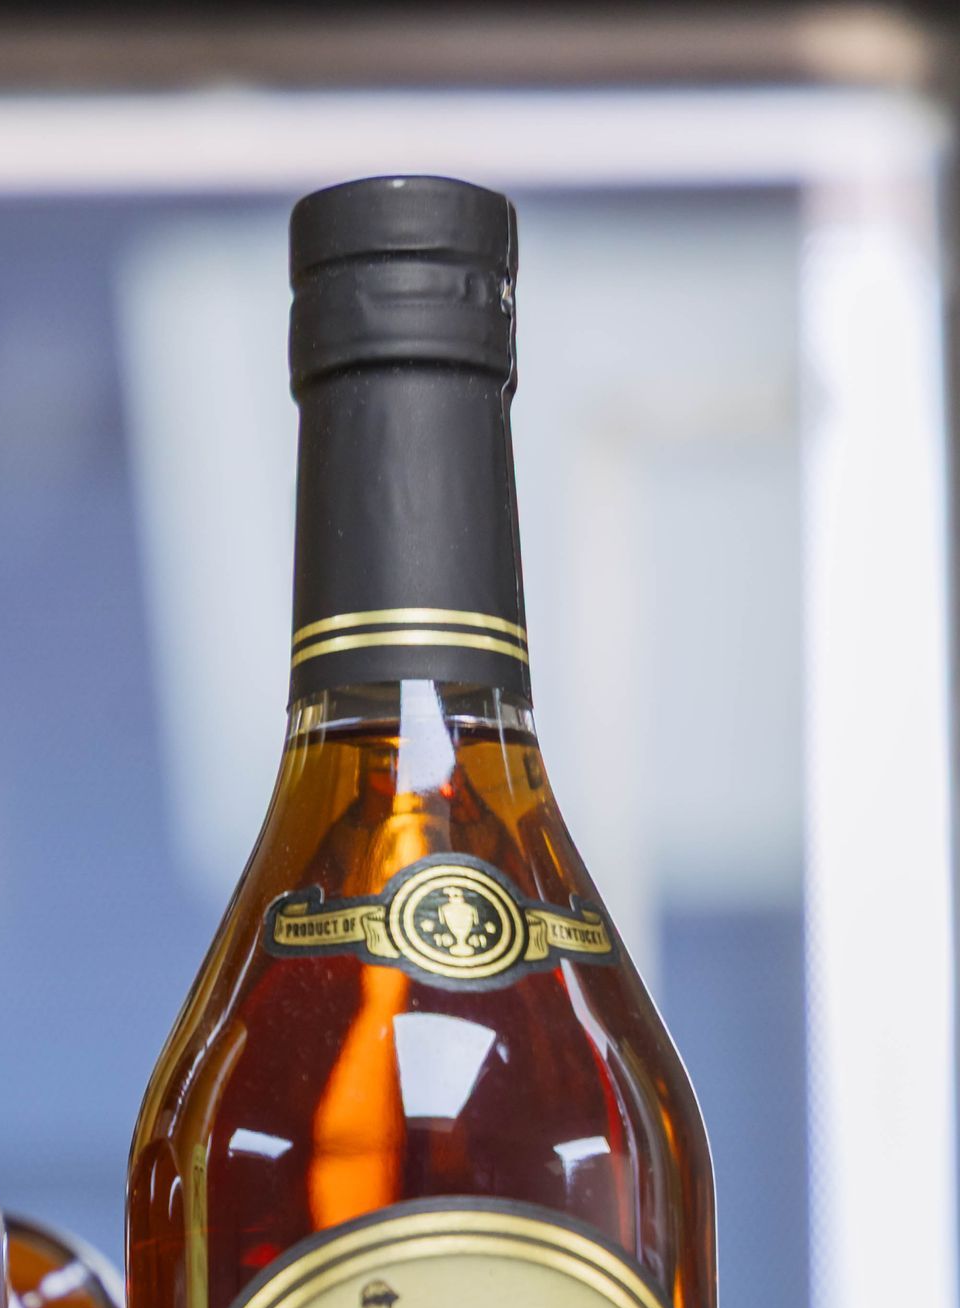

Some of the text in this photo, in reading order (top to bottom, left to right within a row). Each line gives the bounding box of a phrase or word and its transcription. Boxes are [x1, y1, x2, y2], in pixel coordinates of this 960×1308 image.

[285, 917, 356, 938] PRODUCT OF
[551, 923, 603, 945] KENTUCKY
